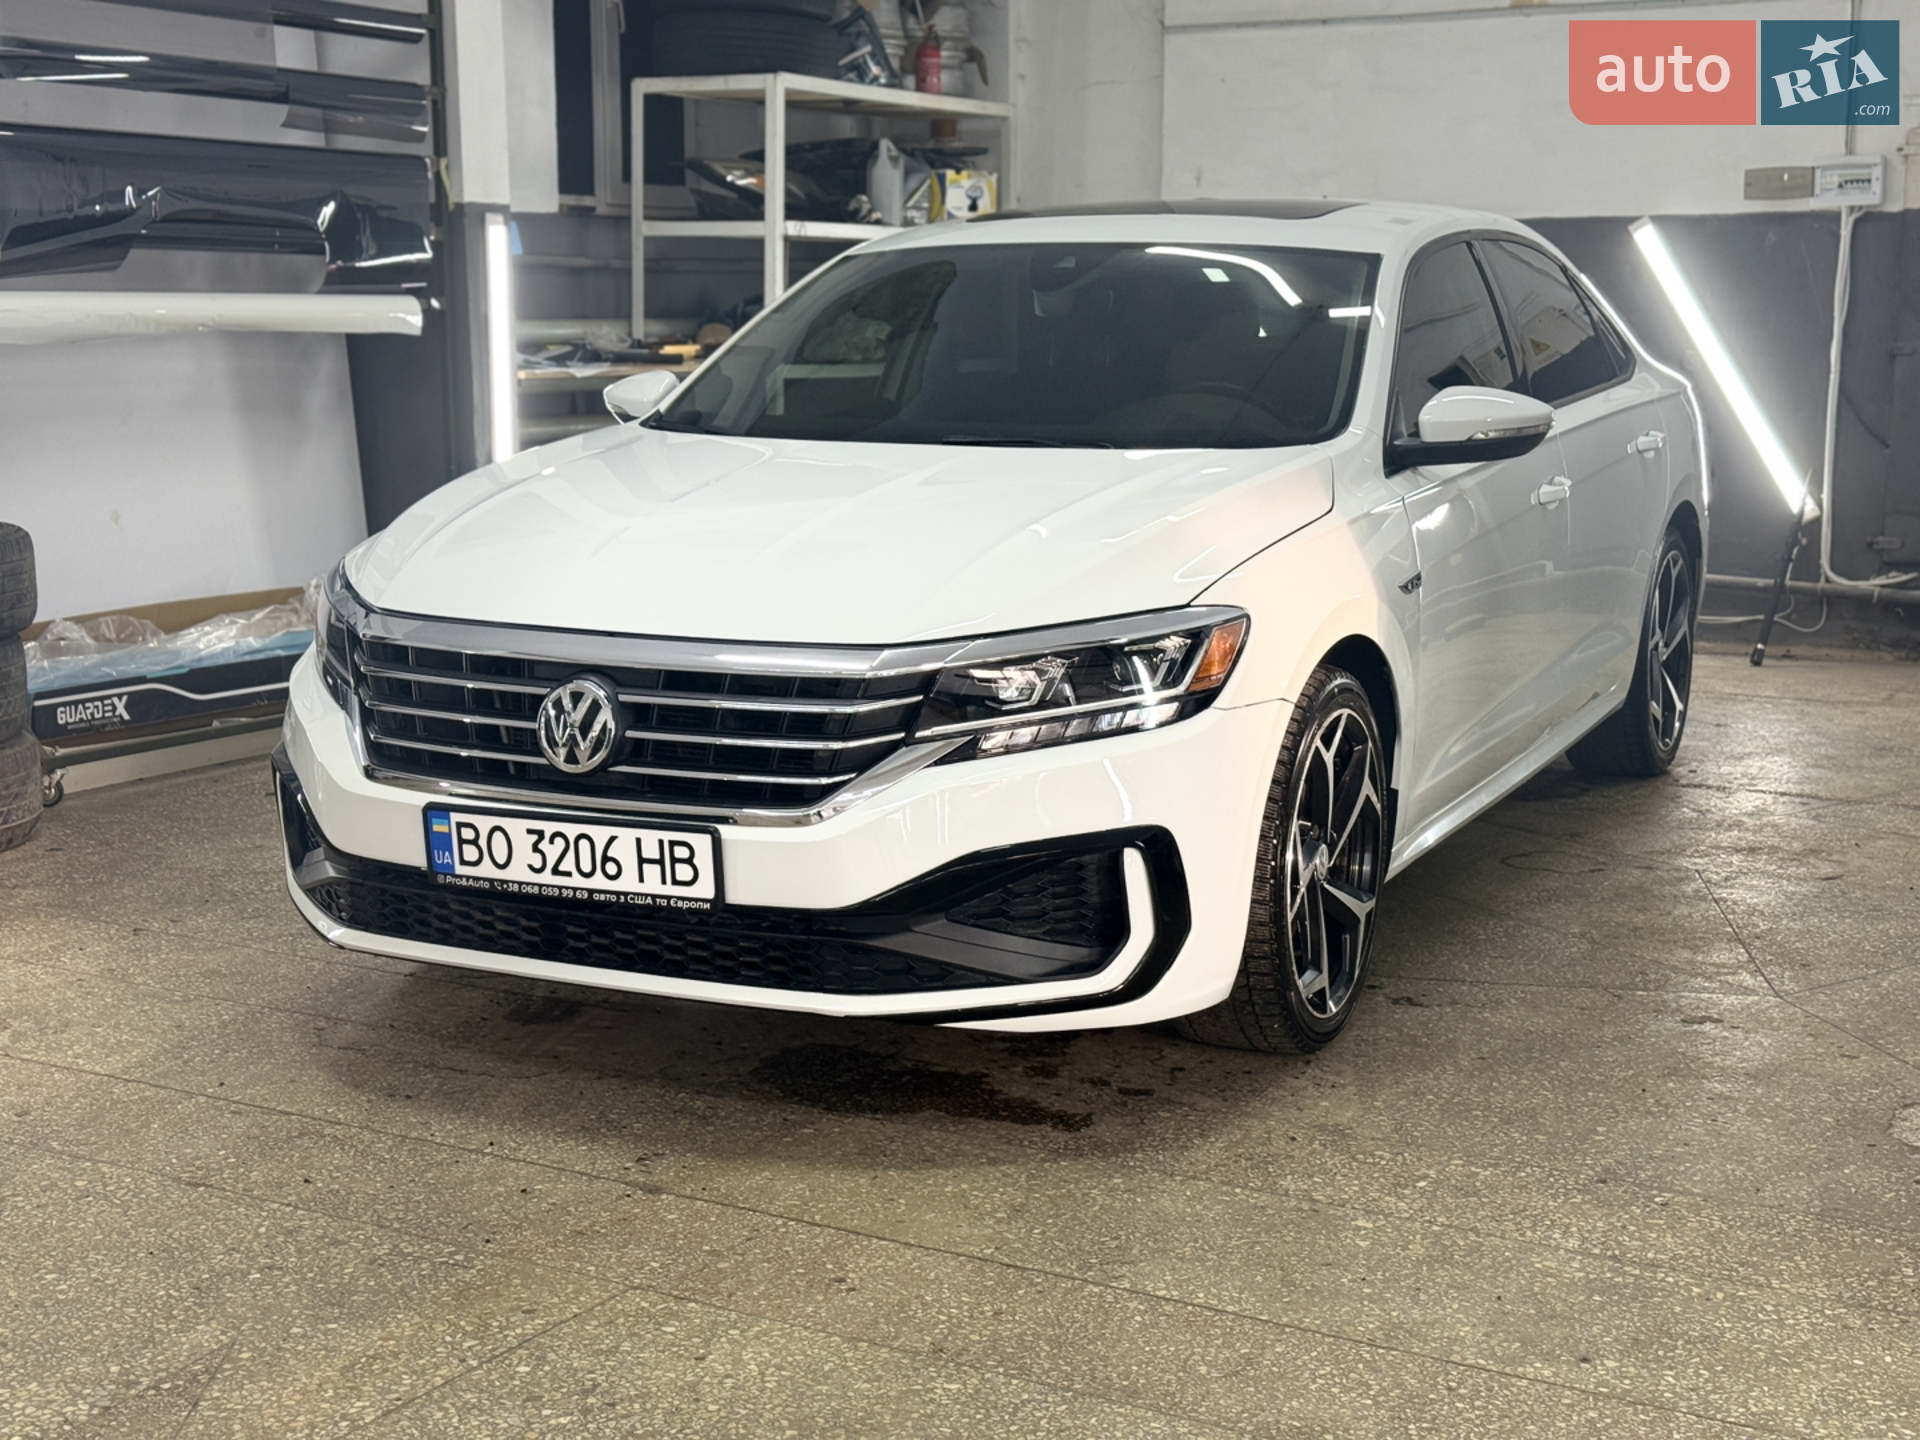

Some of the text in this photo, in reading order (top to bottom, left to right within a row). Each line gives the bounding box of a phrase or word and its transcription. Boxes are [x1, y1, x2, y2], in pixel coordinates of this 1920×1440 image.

[57, 695, 131, 725] GUARDEX
[434, 850, 453, 866] UA
[455, 821, 700, 887] BO 3206 HB
[446, 875, 588, 899] Pro&Auto +38 068 059 99 69
[593, 893, 711, 910] авто з США та Європи
